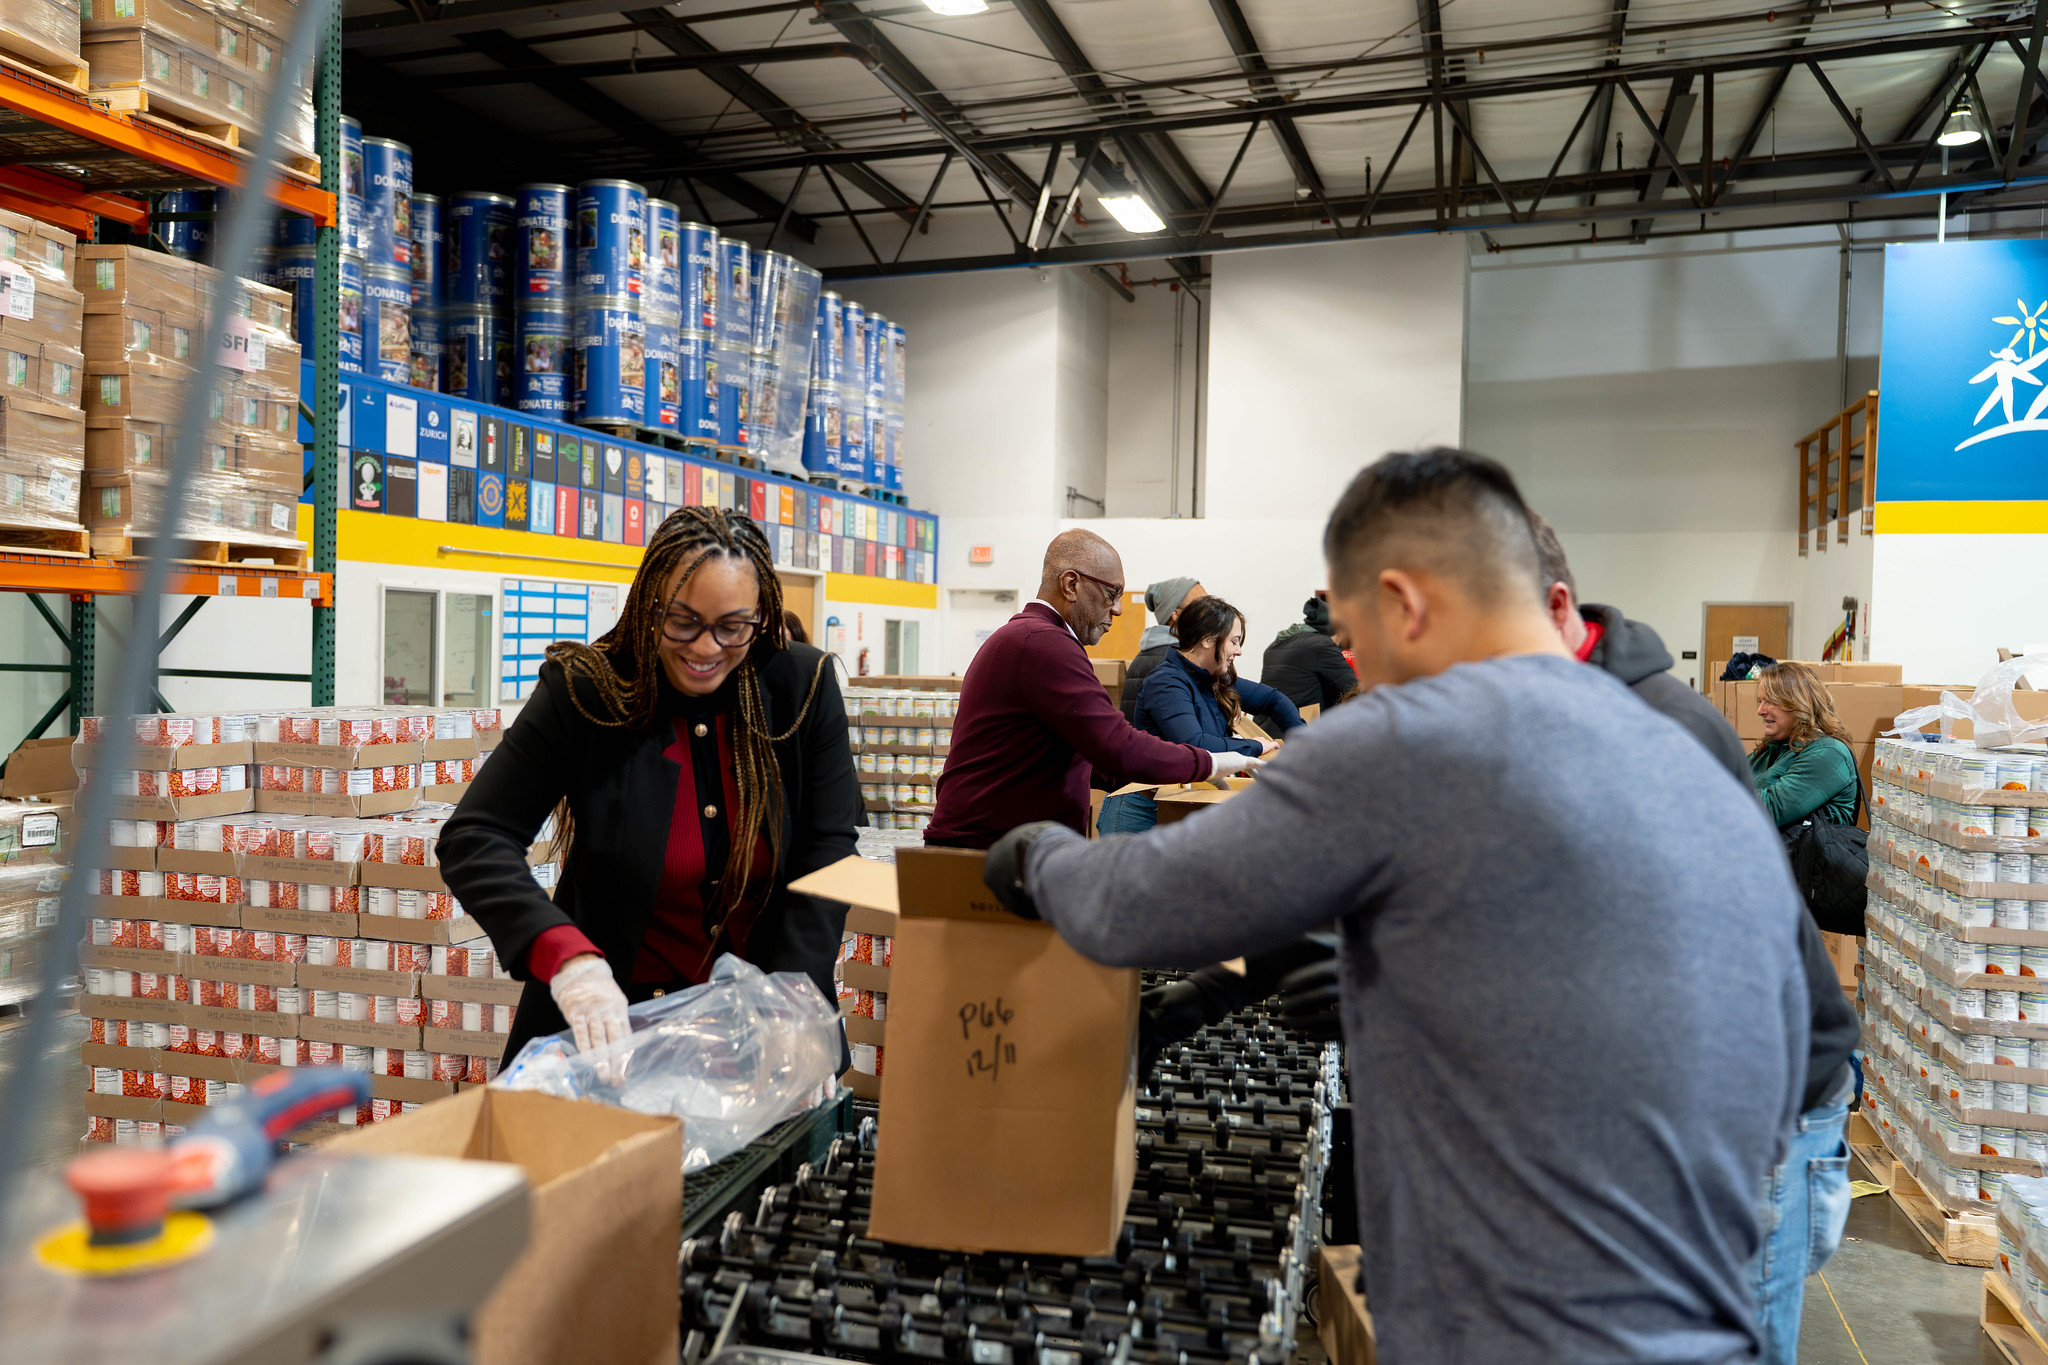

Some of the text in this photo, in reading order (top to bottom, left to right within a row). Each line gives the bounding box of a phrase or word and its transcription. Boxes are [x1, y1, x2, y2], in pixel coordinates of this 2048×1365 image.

[285, 267, 314, 279] HERE!
[366, 286, 405, 303] DONATE
[519, 399, 552, 411] DONATE
[419, 427, 447, 440] ZURICH
[537, 443, 552, 454] KIND
[424, 466, 441, 475] Optum
[559, 491, 567, 534] GameStop
[966, 1034, 1016, 1083] 12/11
